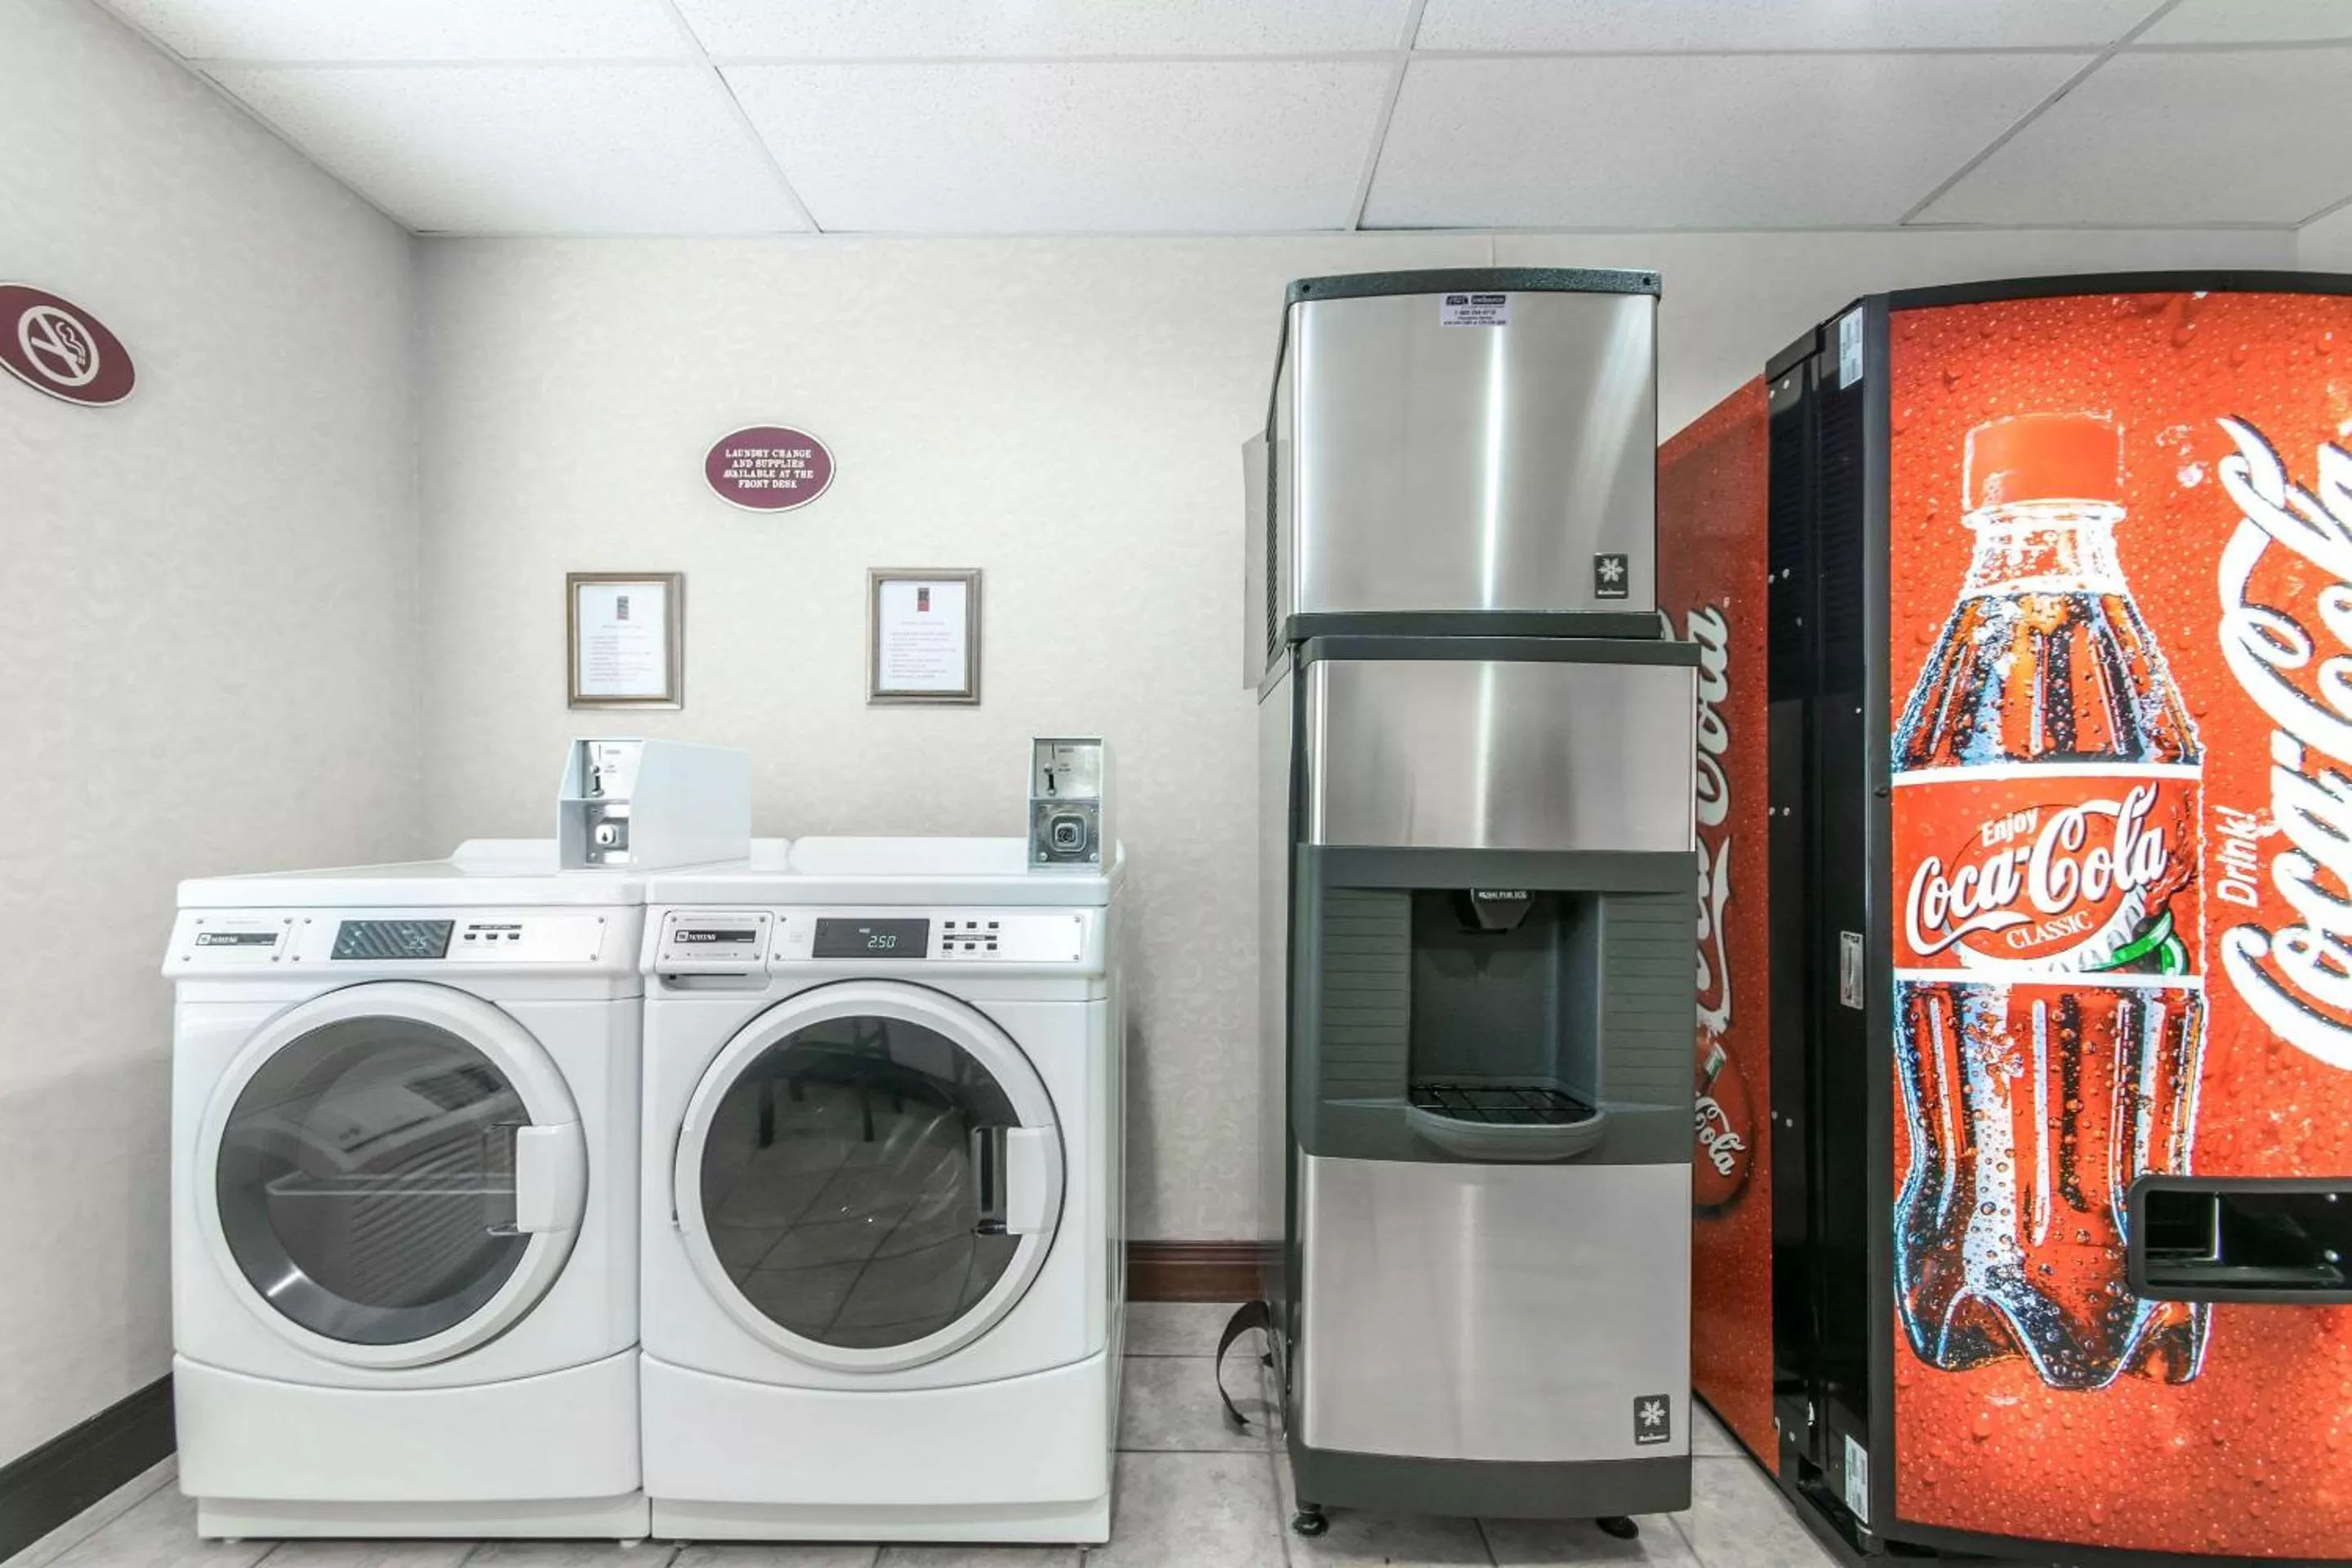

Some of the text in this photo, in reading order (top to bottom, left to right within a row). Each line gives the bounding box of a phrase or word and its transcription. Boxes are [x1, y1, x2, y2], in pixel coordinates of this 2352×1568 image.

[725, 449, 812, 458] LAUNDRY CHANGE
[732, 459, 805, 468] AND SUPPLIES
[724, 470, 814, 479] AVAILABLE AT THE
[738, 479, 798, 488] FRONT DESK
[1980, 807, 2039, 848] Enjoy
[2214, 804, 2258, 908] Drink!
[1905, 780, 2169, 956] Coca-Cola
[2007, 910, 2095, 949] CLASSIC
[867, 935, 897, 948] 2.50
